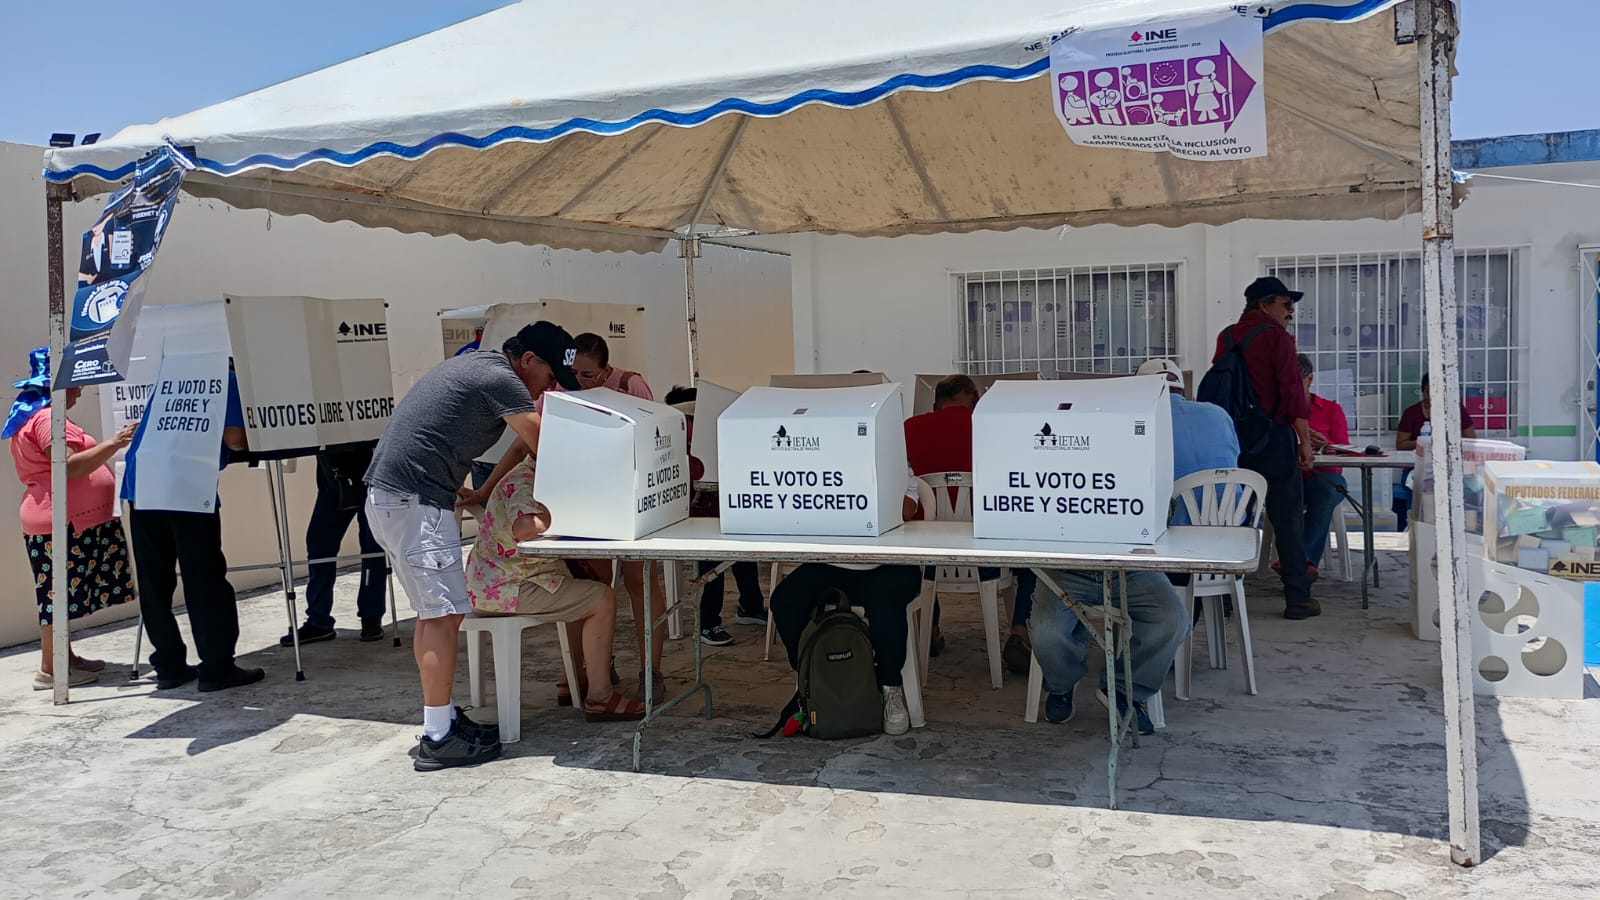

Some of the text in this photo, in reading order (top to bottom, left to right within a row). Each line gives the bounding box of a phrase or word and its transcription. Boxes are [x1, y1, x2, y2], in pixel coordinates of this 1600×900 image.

[1145, 28, 1177, 41] INE
[1120, 134, 1170, 143] GARANTIZA
[1170, 139, 1182, 147] LA
[1184, 137, 1237, 148] INCLUSIÓN
[1209, 147, 1222, 156] AL
[1223, 146, 1252, 155] VOTO
[353, 323, 388, 337] INE
[613, 323, 626, 334] INE
[75, 360, 100, 370] CERO
[116, 385, 127, 401] EL
[161, 378, 222, 395] EL VOTO ES
[125, 404, 145, 420] LIBR
[165, 398, 211, 413] LIBRE Y
[246, 406, 258, 429] EL
[257, 404, 296, 429] VOTO
[297, 403, 316, 426] ES
[319, 401, 345, 424] LIBRE
[345, 400, 355, 421] Y
[157, 416, 210, 432] SECRETO
[793, 436, 820, 447] IETAM
[1058, 435, 1090, 447] IETAM
[647, 463, 680, 488] EL VOTO ES
[750, 471, 844, 487] EL VOTO ES
[1008, 471, 1116, 490] EL VOTO ES
[637, 493, 657, 514] LIBRE
[662, 482, 688, 505] SECRETO
[1505, 485, 1600, 500] DIPUTADOS FEDERALE
[728, 493, 868, 511] LIBRE Y SECRETO
[983, 495, 1144, 516] LIBRE Y SECRETO
[1570, 562, 1600, 575] INE
